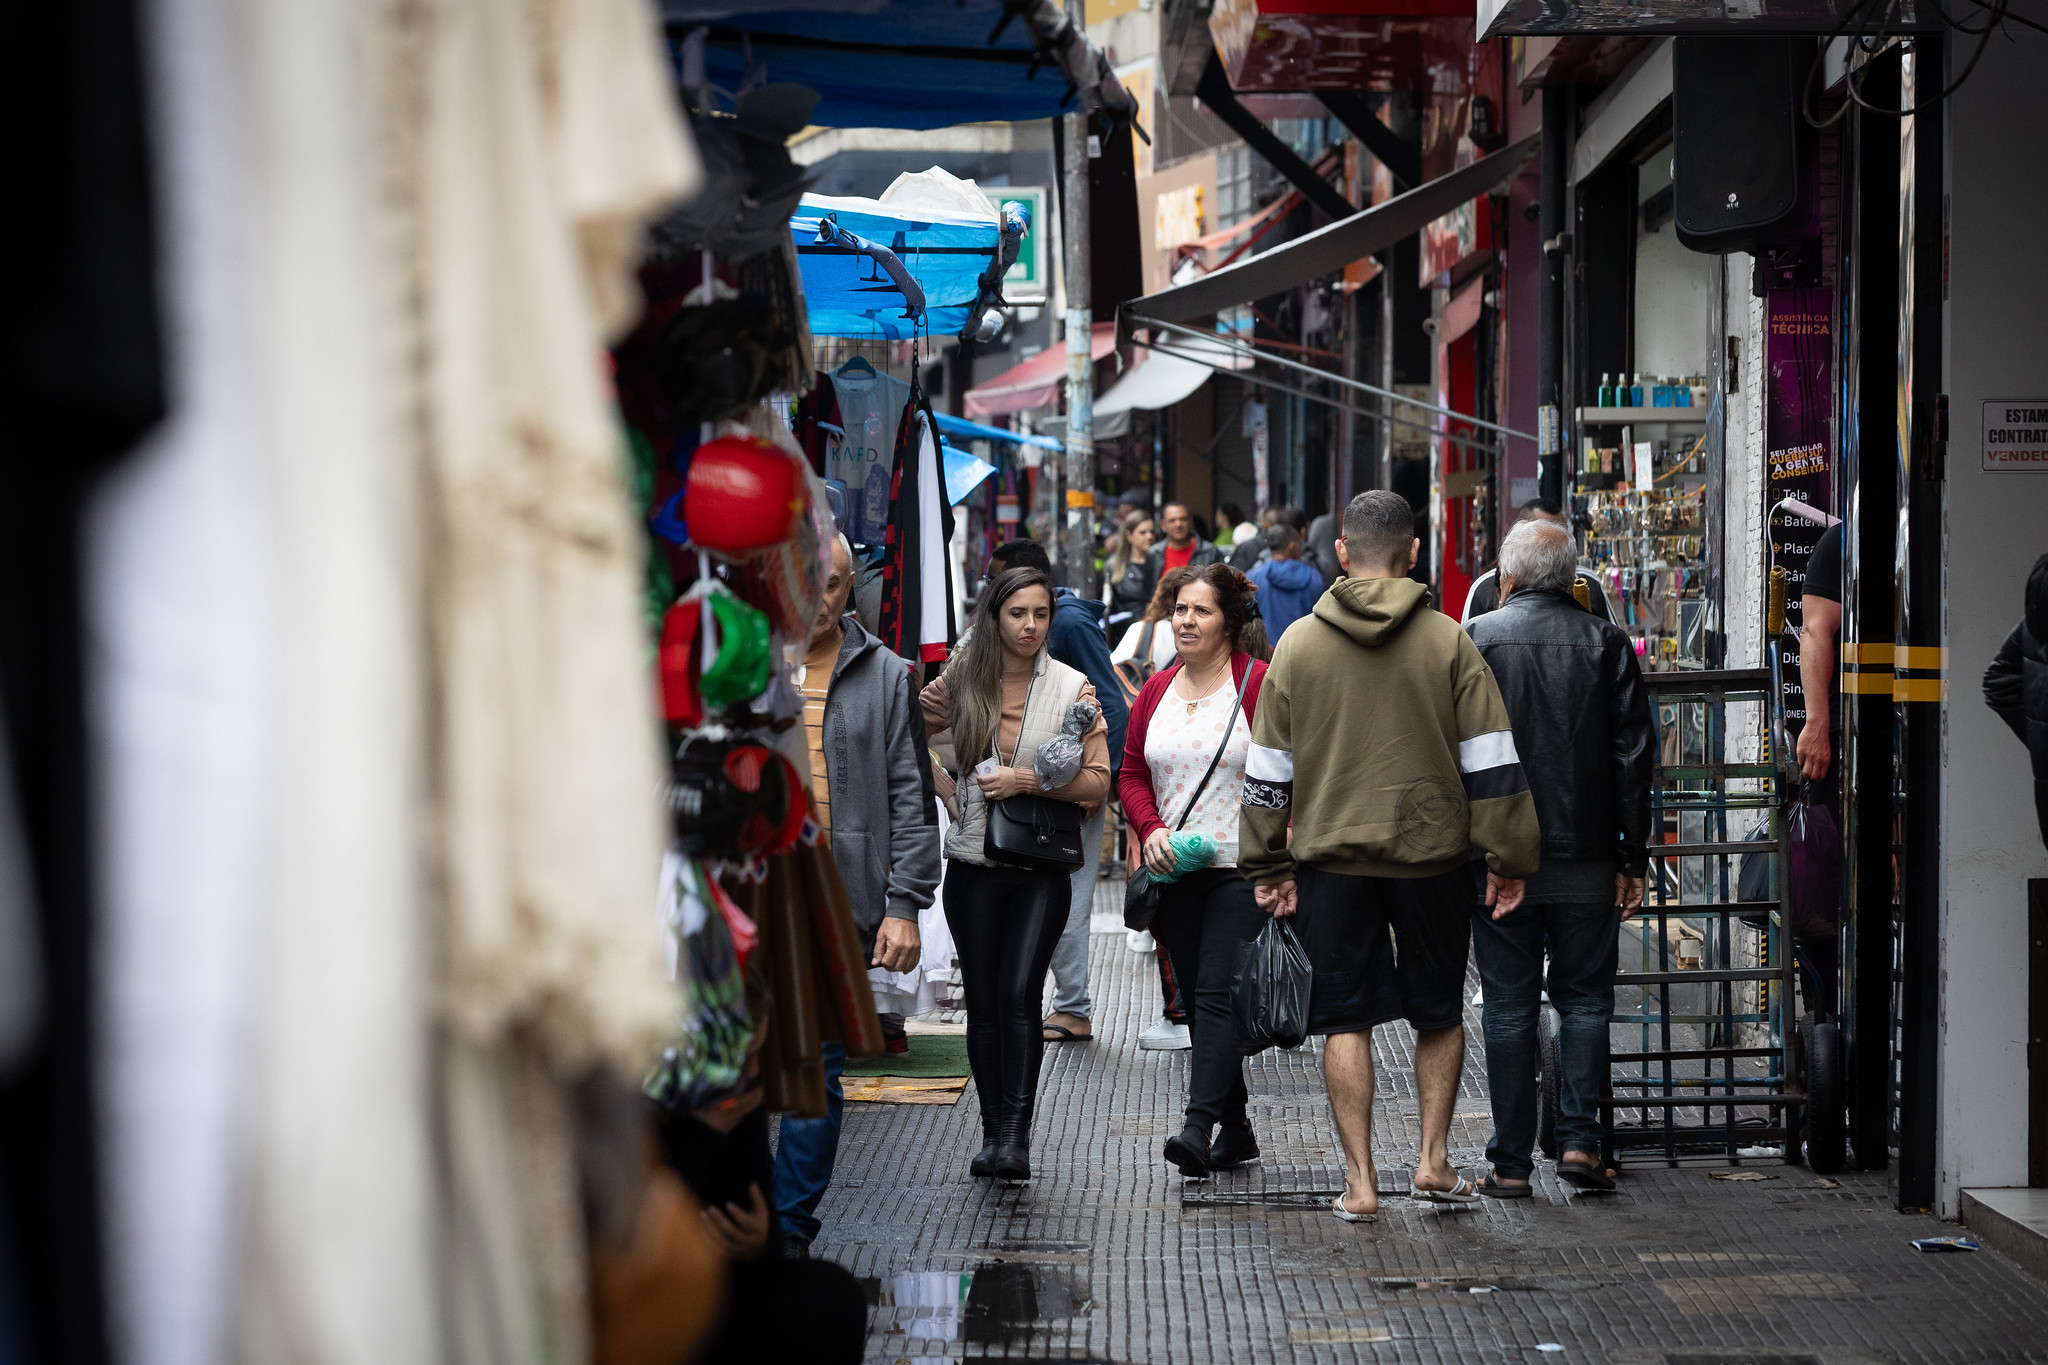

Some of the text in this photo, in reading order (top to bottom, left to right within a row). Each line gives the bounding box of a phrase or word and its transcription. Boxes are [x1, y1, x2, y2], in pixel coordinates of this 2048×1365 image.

[1771, 321, 1830, 335] TÉCNICA
[2005, 408, 2048, 423] ESTAM
[1988, 429, 2048, 444] CONTRAT
[1769, 442, 1823, 458] SEU CELULAR
[1774, 456, 1824, 473] A GENTE
[1783, 489, 1808, 500] Tela
[1783, 683, 1804, 694] Sin
